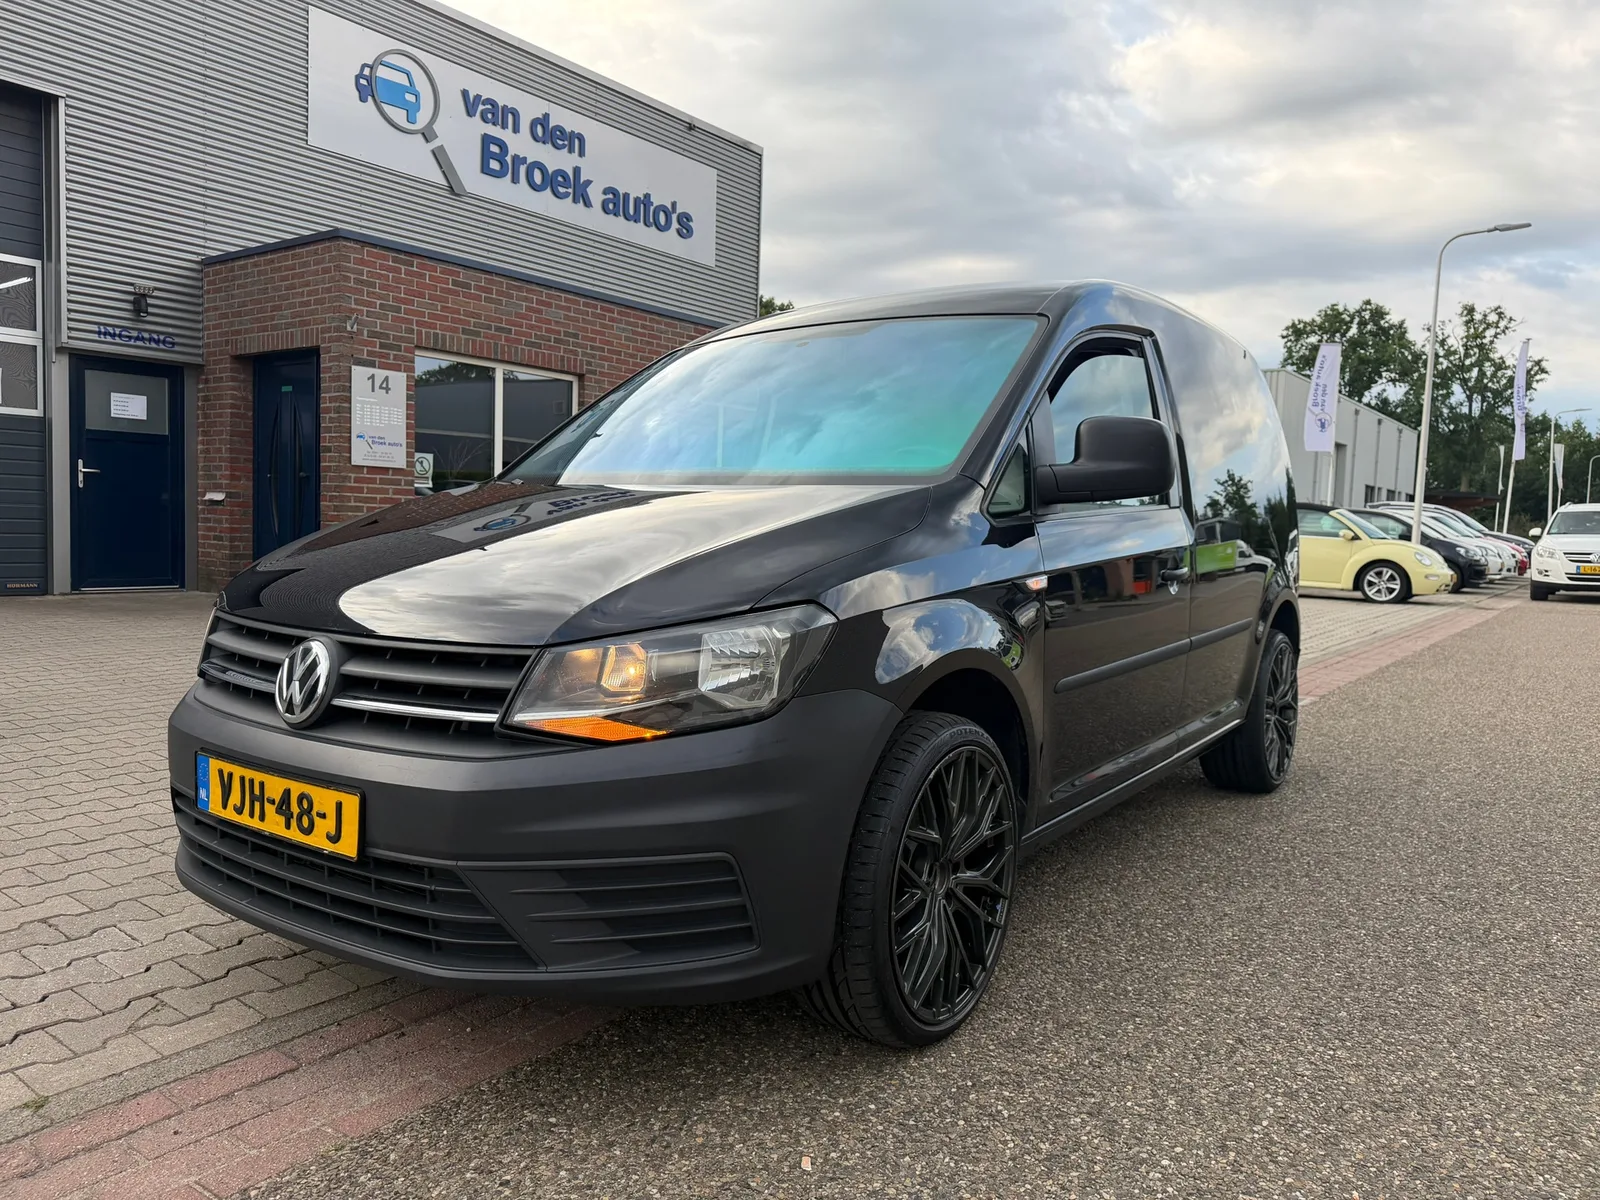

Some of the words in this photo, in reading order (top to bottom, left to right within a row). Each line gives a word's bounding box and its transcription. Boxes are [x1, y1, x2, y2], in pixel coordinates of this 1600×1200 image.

[461, 88, 521, 134] van
[530, 112, 586, 158] den
[480, 132, 593, 208] Broek
[602, 186, 694, 239] auto's
[97, 326, 176, 348] INGANG
[367, 373, 391, 394] 14
[199, 787, 208, 801] NL
[217, 768, 343, 844] VJH-48-J
